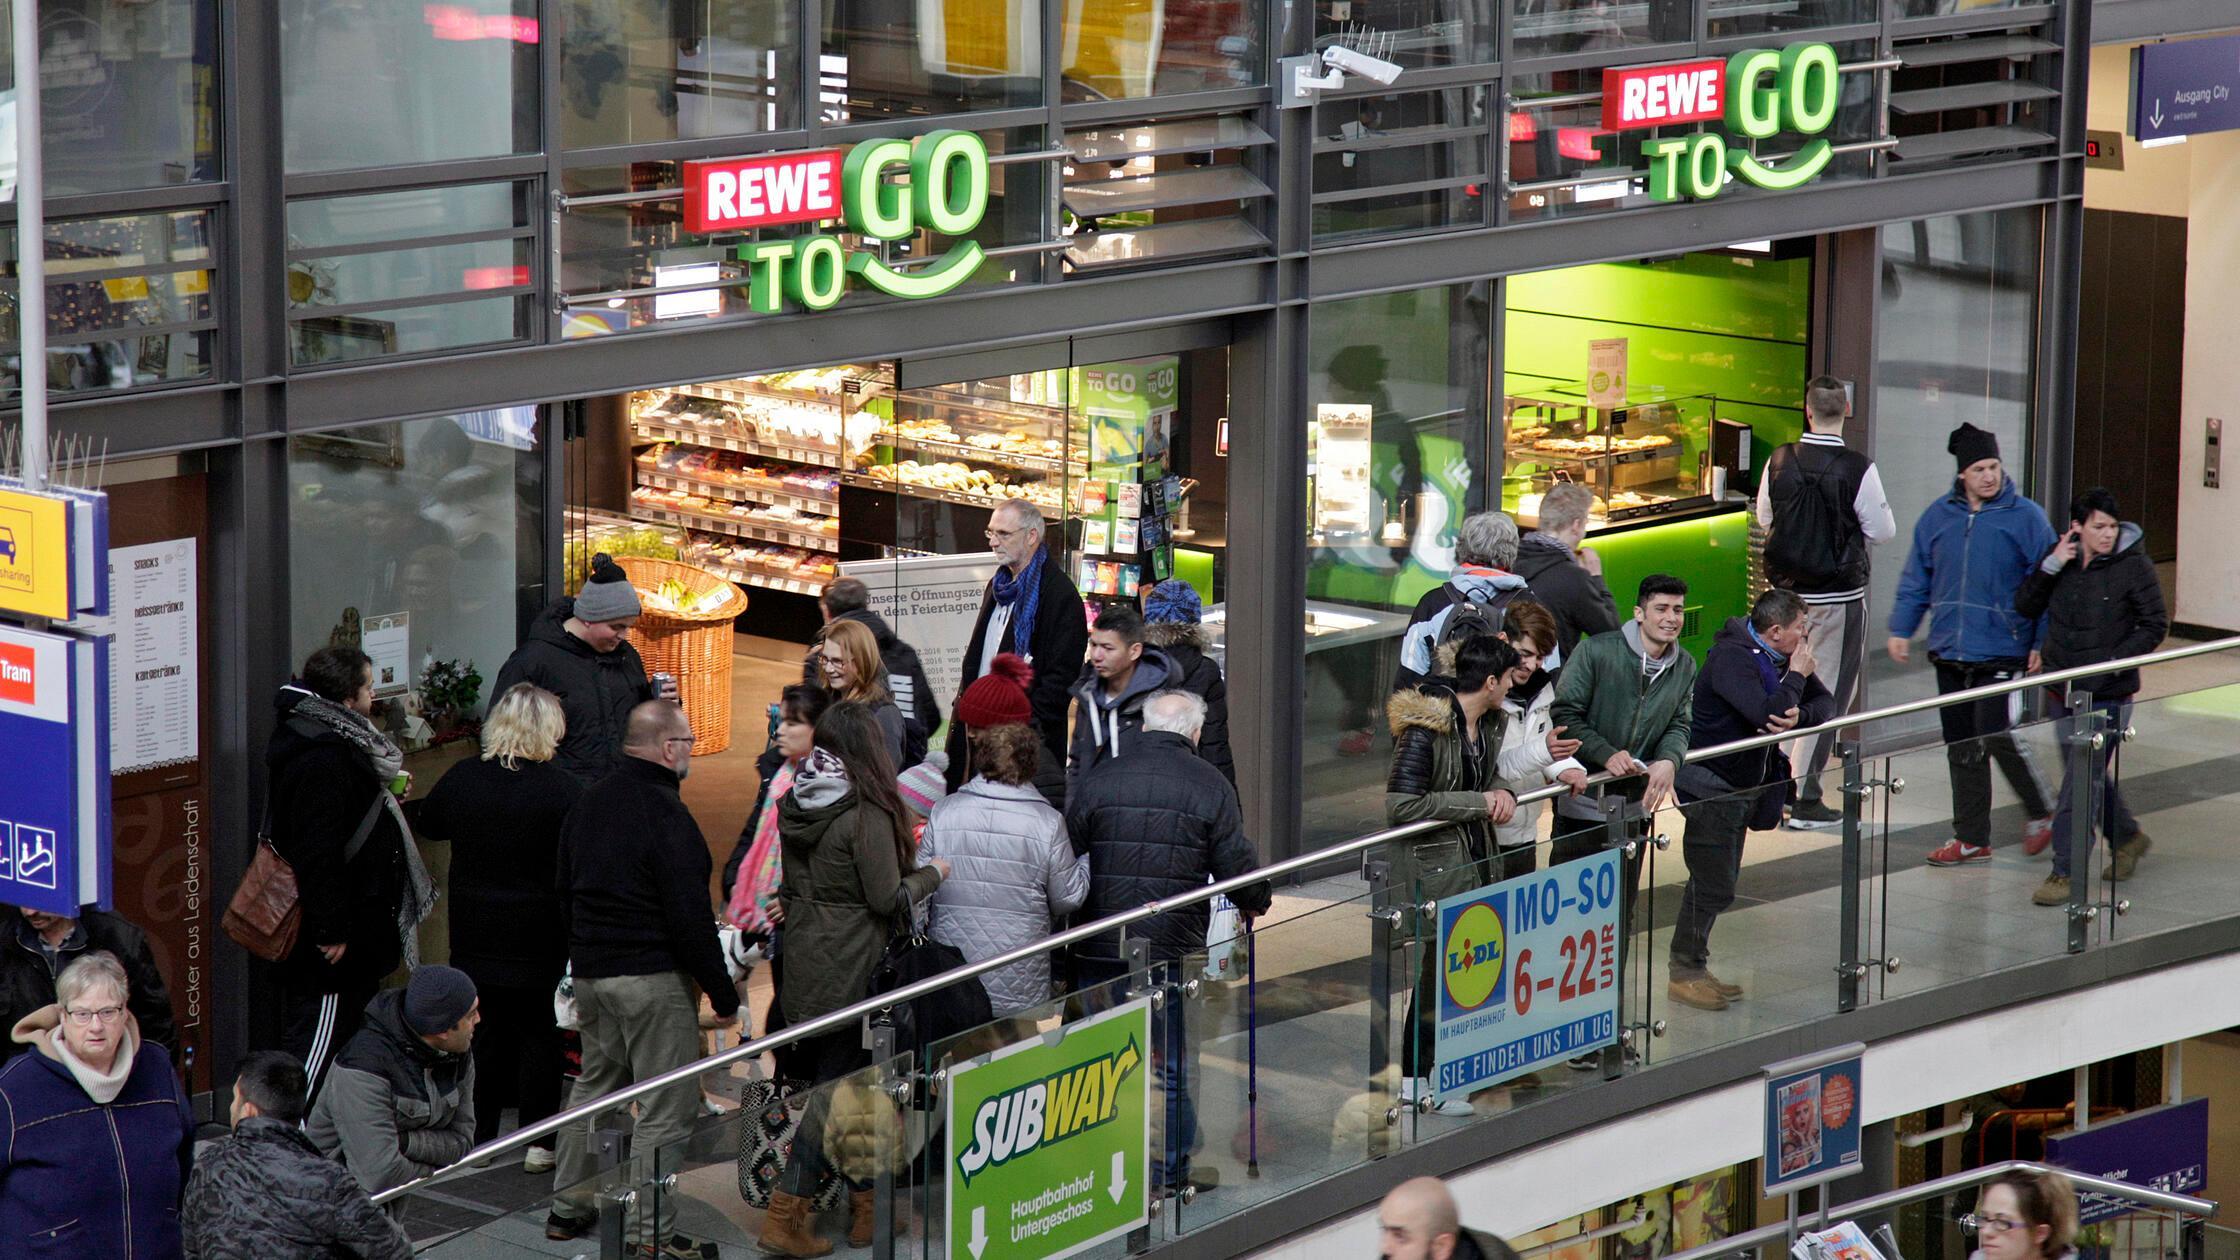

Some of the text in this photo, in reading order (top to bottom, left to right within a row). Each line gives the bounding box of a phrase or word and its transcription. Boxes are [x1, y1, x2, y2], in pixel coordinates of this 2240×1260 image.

[2174, 85, 2230, 105] Ausgang City
[1622, 42, 1839, 200] REWE TO GO
[708, 131, 989, 312] REWE TO GO
[1088, 379, 1104, 392] TO
[1106, 372, 1136, 392] GO
[1157, 368, 1174, 388] GO
[865, 593, 907, 605] Unsere
[884, 607, 908, 617] den
[0, 659, 31, 685] Tram
[184, 799, 200, 1027] Lecker aus Leidenschaft
[1600, 922, 1615, 990] UHR
[1440, 1008, 1506, 1041] IM HAUPTBAHNHOF
[1441, 1061, 1465, 1089] SIE
[1473, 1041, 1526, 1079] FINDEN
[1533, 1030, 1561, 1059] UNS
[1568, 1022, 1585, 1046] IM
[1592, 1013, 1611, 1040] UG
[957, 1035, 1141, 1184] SUBWAY
[1011, 1170, 1095, 1221] Hauptbahnhof
[1010, 1198, 1093, 1243] Untergeschoss
